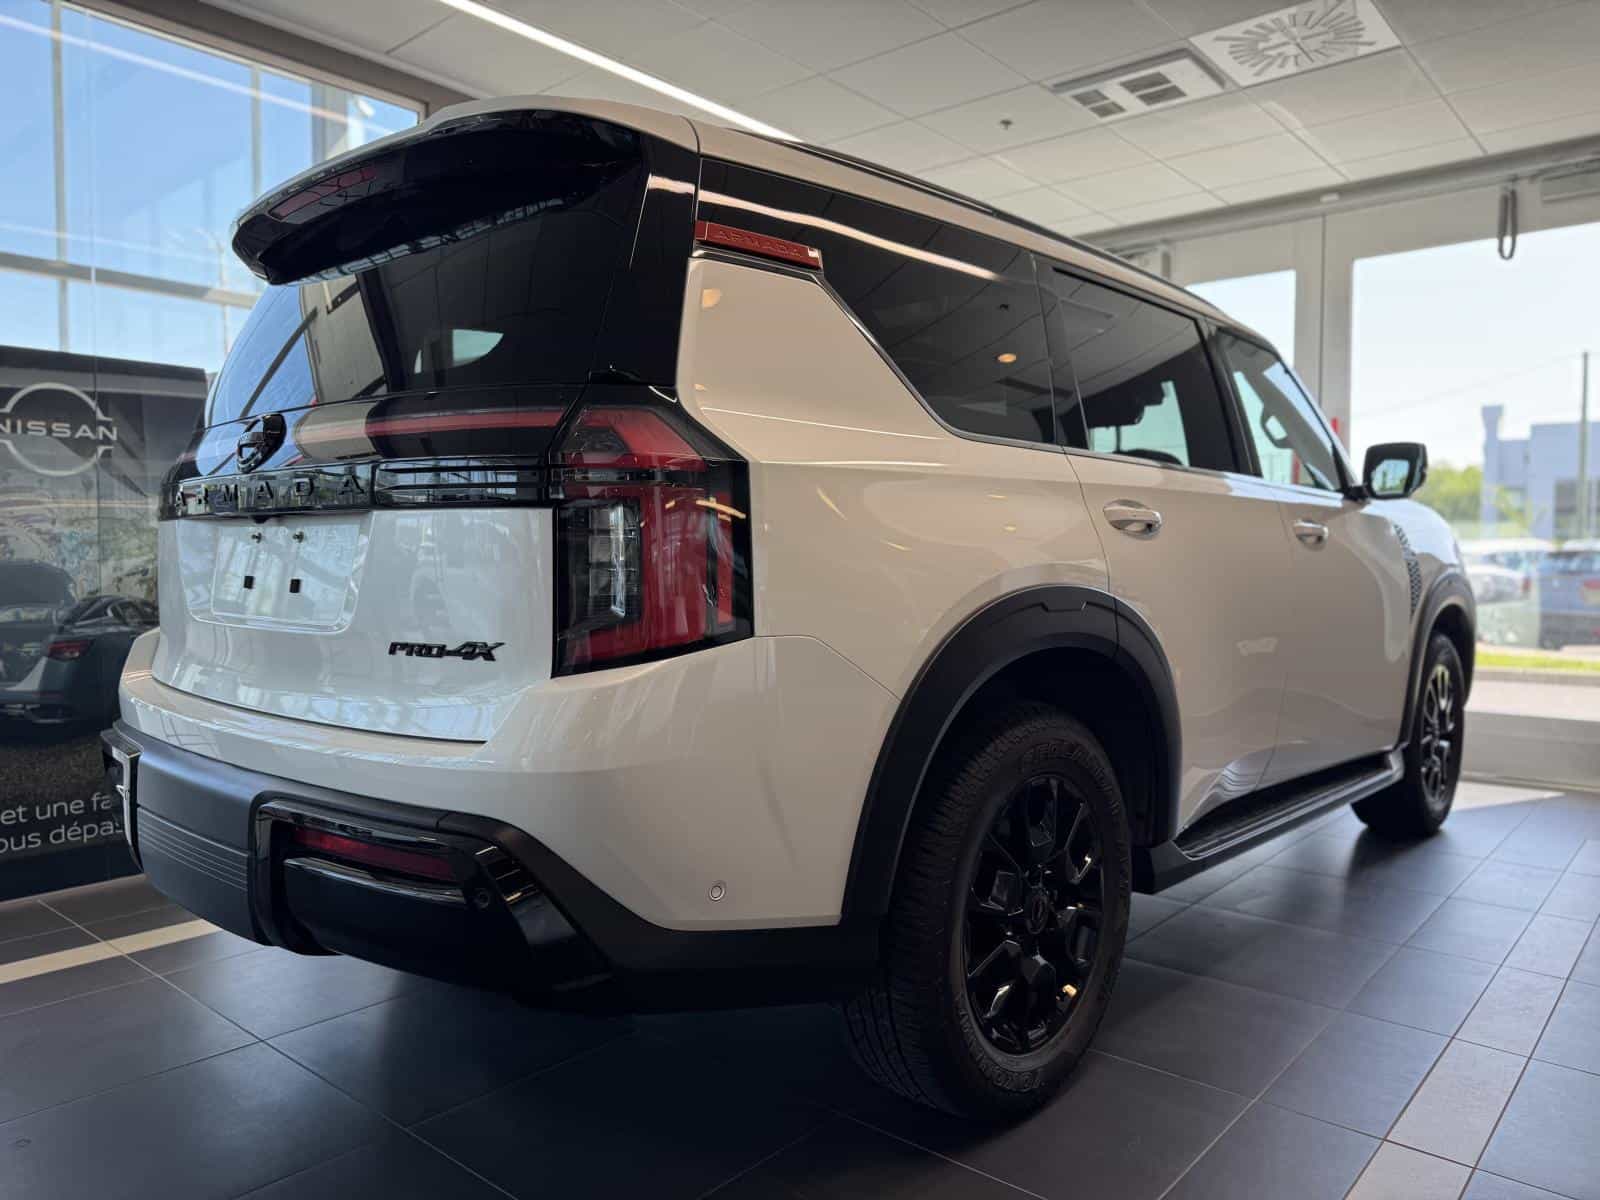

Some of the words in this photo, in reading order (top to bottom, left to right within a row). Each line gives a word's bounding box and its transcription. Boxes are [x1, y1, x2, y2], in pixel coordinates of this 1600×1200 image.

[0, 418, 118, 441] NISSAN
[175, 473, 365, 509] ARMADA
[388, 641, 505, 661] PRO-4X
[0, 804, 28, 825] et
[35, 799, 85, 820] une
